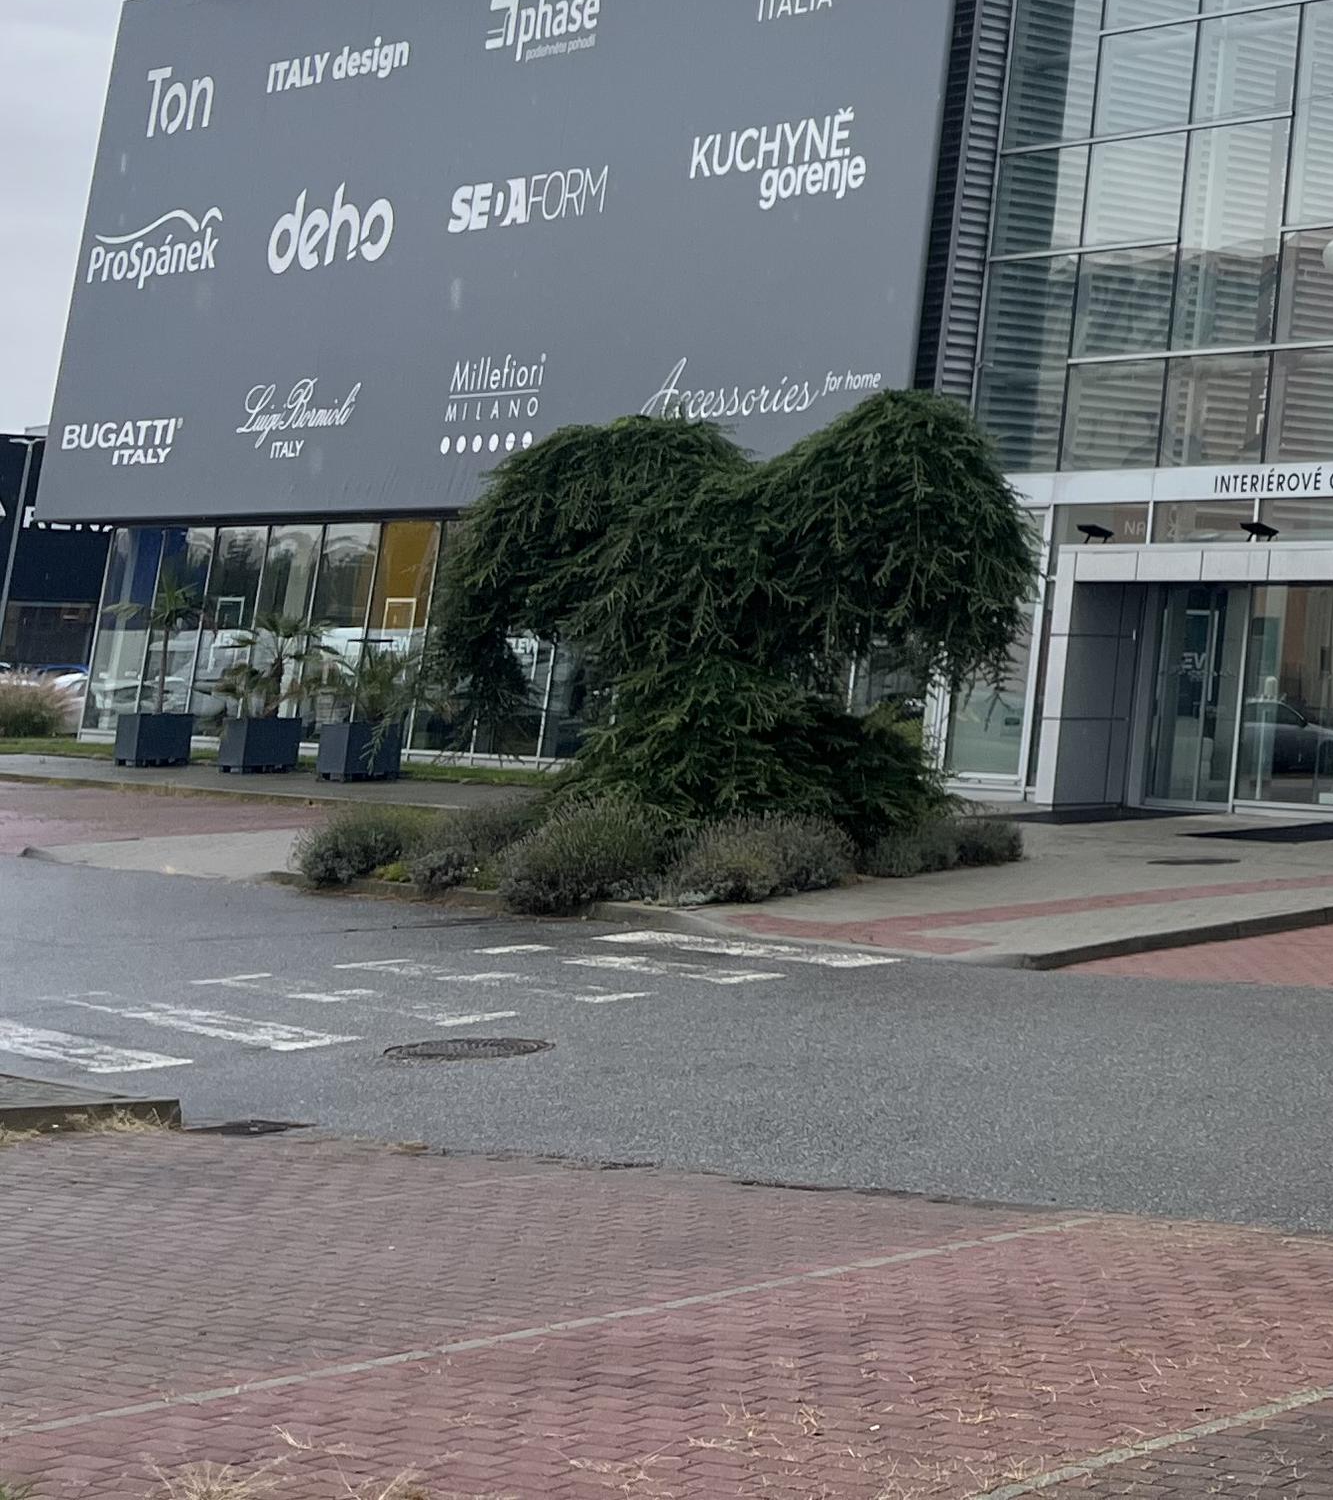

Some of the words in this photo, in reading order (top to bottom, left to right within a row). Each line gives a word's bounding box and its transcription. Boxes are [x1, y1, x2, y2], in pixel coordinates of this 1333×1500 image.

[266, 51, 331, 94] ITALY
[332, 36, 410, 79] design
[146, 66, 215, 138] Ton
[689, 105, 855, 180] KUCHYNĚ
[759, 146, 867, 211] gorenje
[86, 226, 220, 290] ProSpánek
[449, 353, 547, 393] Millefiori
[822, 369, 843, 397] for
[844, 369, 882, 391] home
[444, 396, 539, 422] MILANO
[61, 417, 177, 450] BUGATTI
[269, 439, 305, 459] ITALY
[111, 446, 172, 466] ITALY
[1214, 466, 1323, 494] INTERIÉROVÉ
